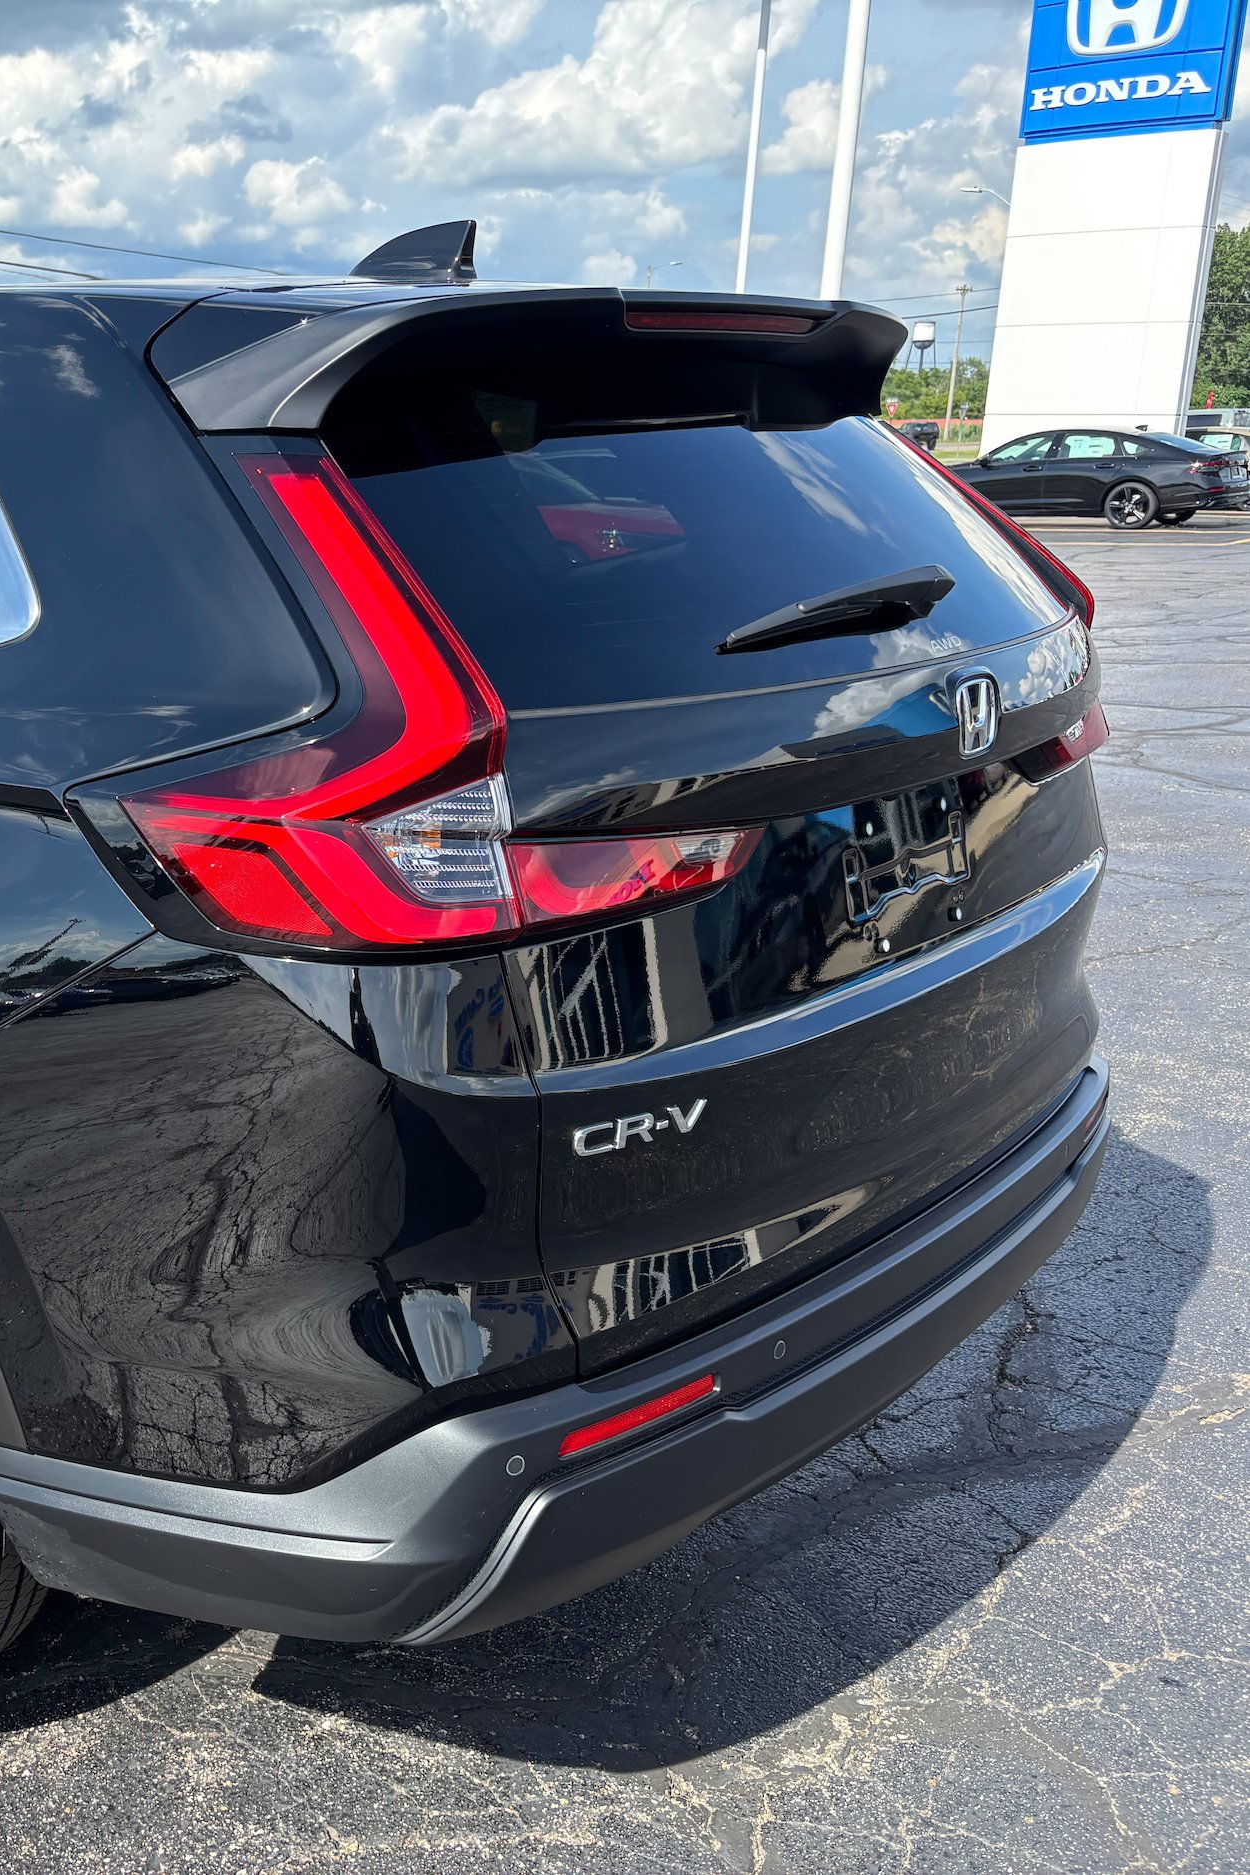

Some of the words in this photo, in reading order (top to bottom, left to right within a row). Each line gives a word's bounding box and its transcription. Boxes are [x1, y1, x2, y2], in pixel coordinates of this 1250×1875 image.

[1029, 71, 1211, 111] HONDA
[930, 635, 962, 652] AWD
[573, 1099, 707, 1157] CR-V
